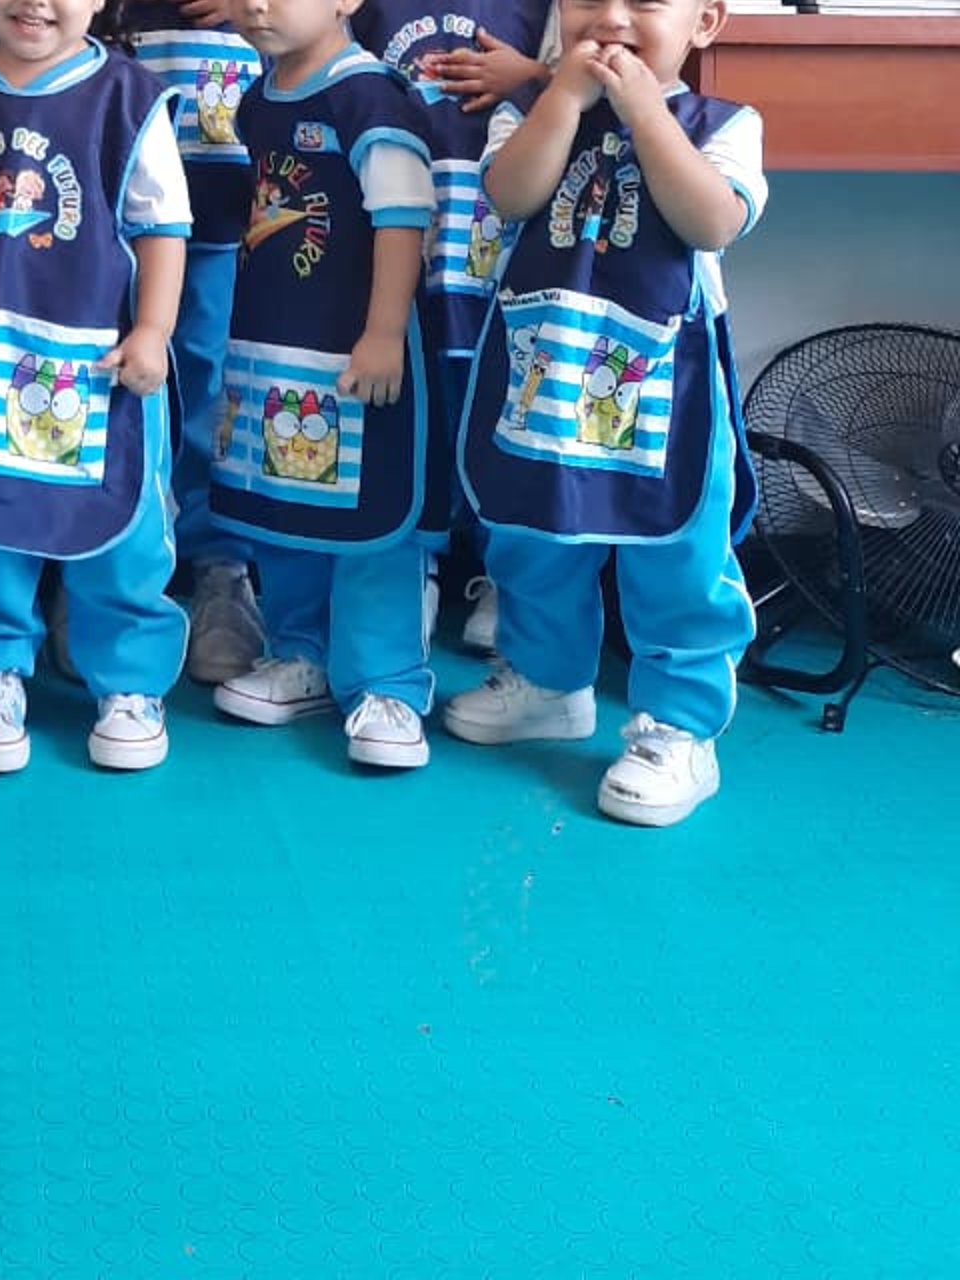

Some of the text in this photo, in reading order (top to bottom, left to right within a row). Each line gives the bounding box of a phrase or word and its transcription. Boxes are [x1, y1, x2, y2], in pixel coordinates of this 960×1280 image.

[12, 127, 50, 161] DEL
[47, 153, 82, 241] FUTURO
[293, 191, 333, 281] FUTURO
